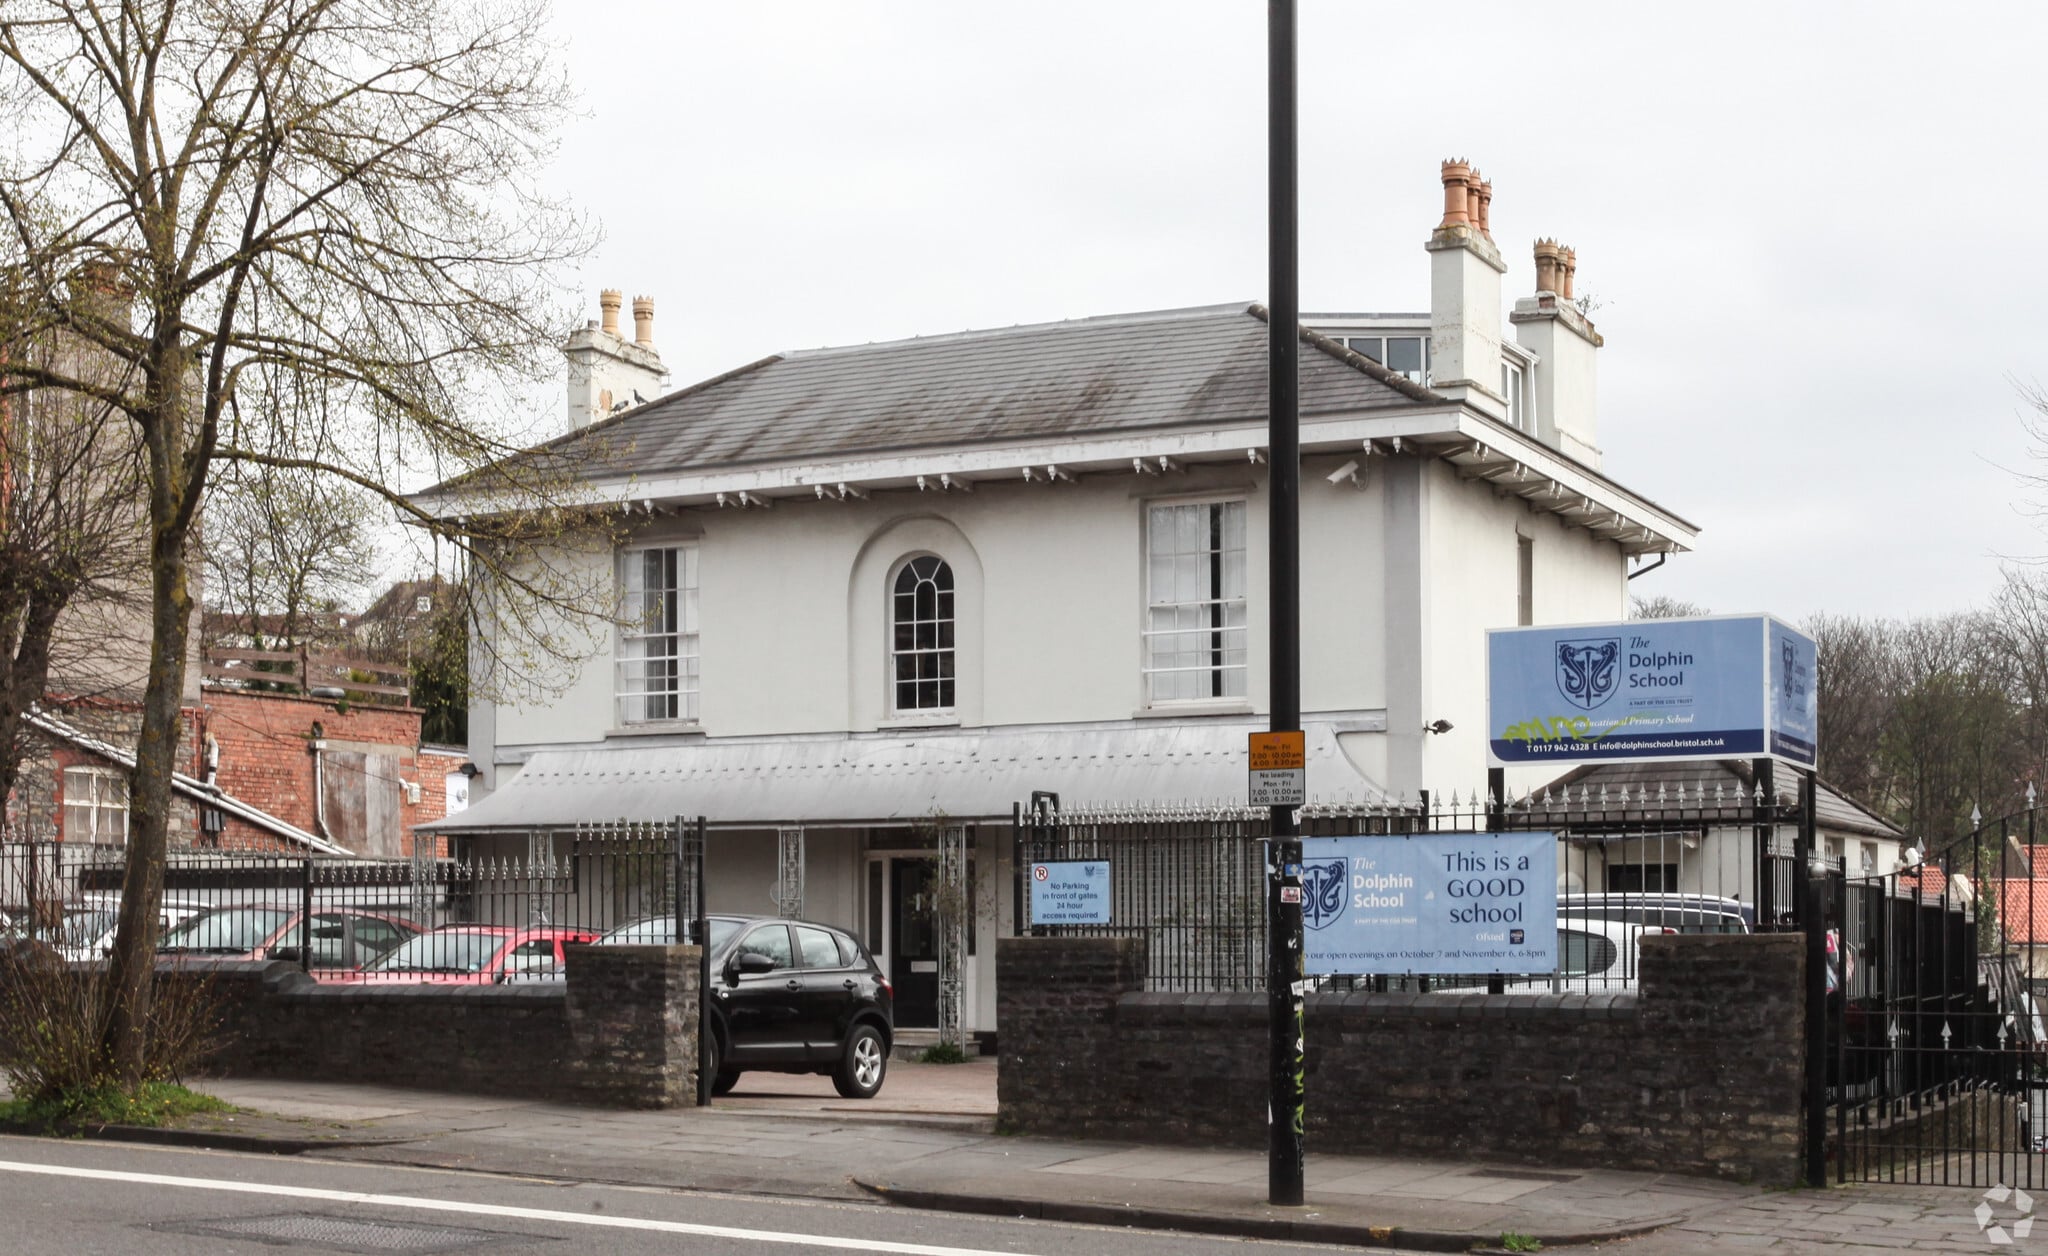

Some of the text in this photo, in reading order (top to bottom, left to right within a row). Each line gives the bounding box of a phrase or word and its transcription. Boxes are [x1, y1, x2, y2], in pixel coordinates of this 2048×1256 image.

[1629, 636, 1650, 649] The
[1629, 651, 1693, 670] Dolphin
[1629, 671, 1683, 688] School
[1629, 716, 1665, 726] Primary
[1666, 713, 1695, 724] School
[1570, 743, 1590, 751] 4328
[1599, 738, 1725, 751] info@dolphinschool.bristol.sch.uk
[1353, 857, 1376, 870] The
[1441, 850, 1529, 872] This is a
[1062, 882, 1090, 890] Parking
[1353, 873, 1413, 892] Dolphin
[1447, 878, 1525, 898] GOOD
[1078, 892, 1098, 900] gates
[1354, 892, 1404, 908] School
[1449, 901, 1523, 923] school
[1475, 932, 1504, 942] Ofsted
[1326, 952, 1347, 960] open
[1349, 951, 1385, 961] evenings
[1400, 949, 1435, 958] October
[1444, 949, 1460, 958] and
[1462, 949, 1506, 958] November
[1518, 949, 1546, 959] 6-8pm
